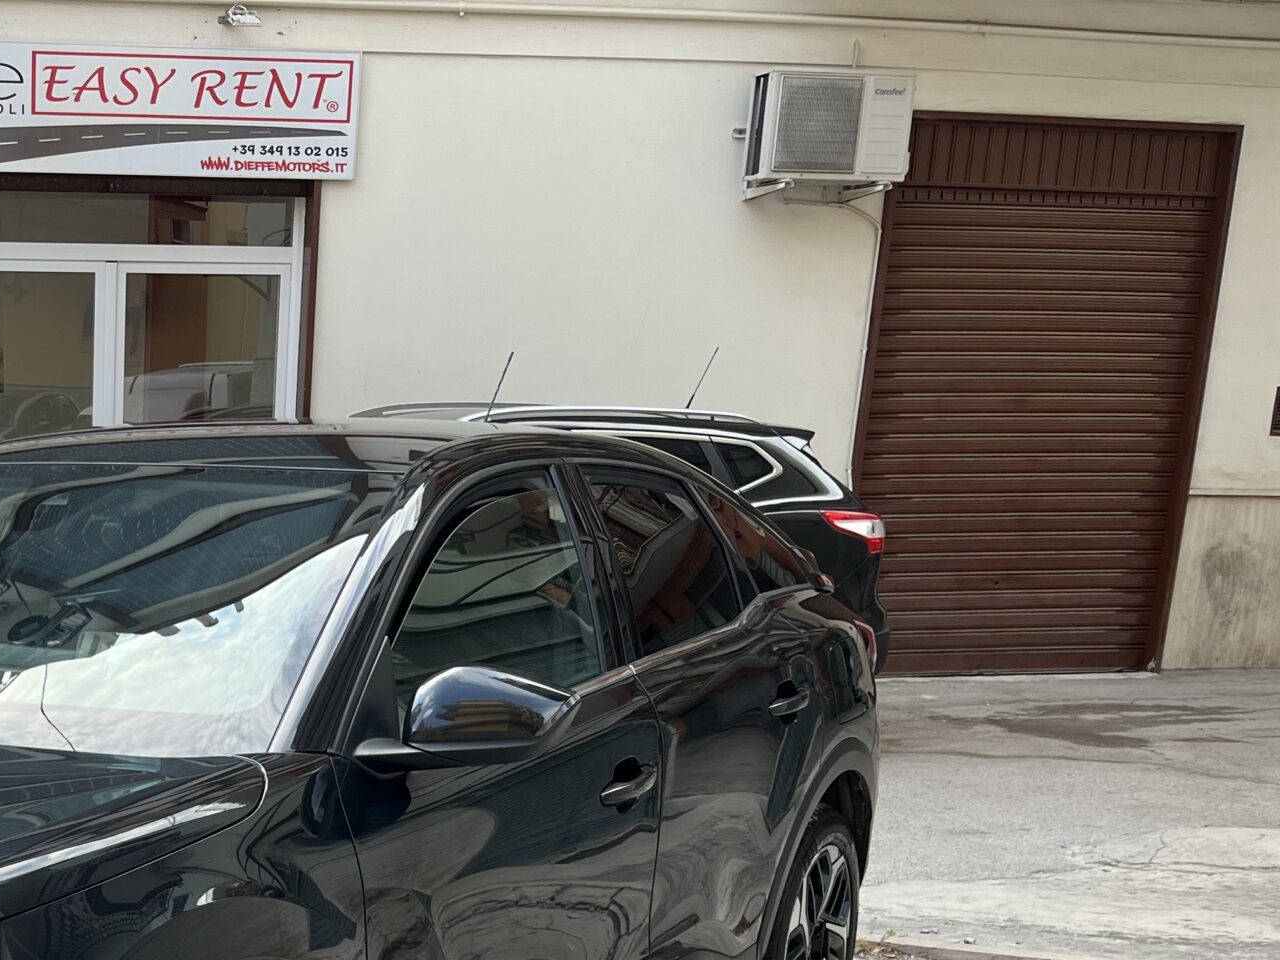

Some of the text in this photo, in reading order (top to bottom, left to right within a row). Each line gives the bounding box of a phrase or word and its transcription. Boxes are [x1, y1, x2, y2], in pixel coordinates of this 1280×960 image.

[42, 65, 177, 106] EASY
[232, 144, 348, 157] +39 349 13 02 015
